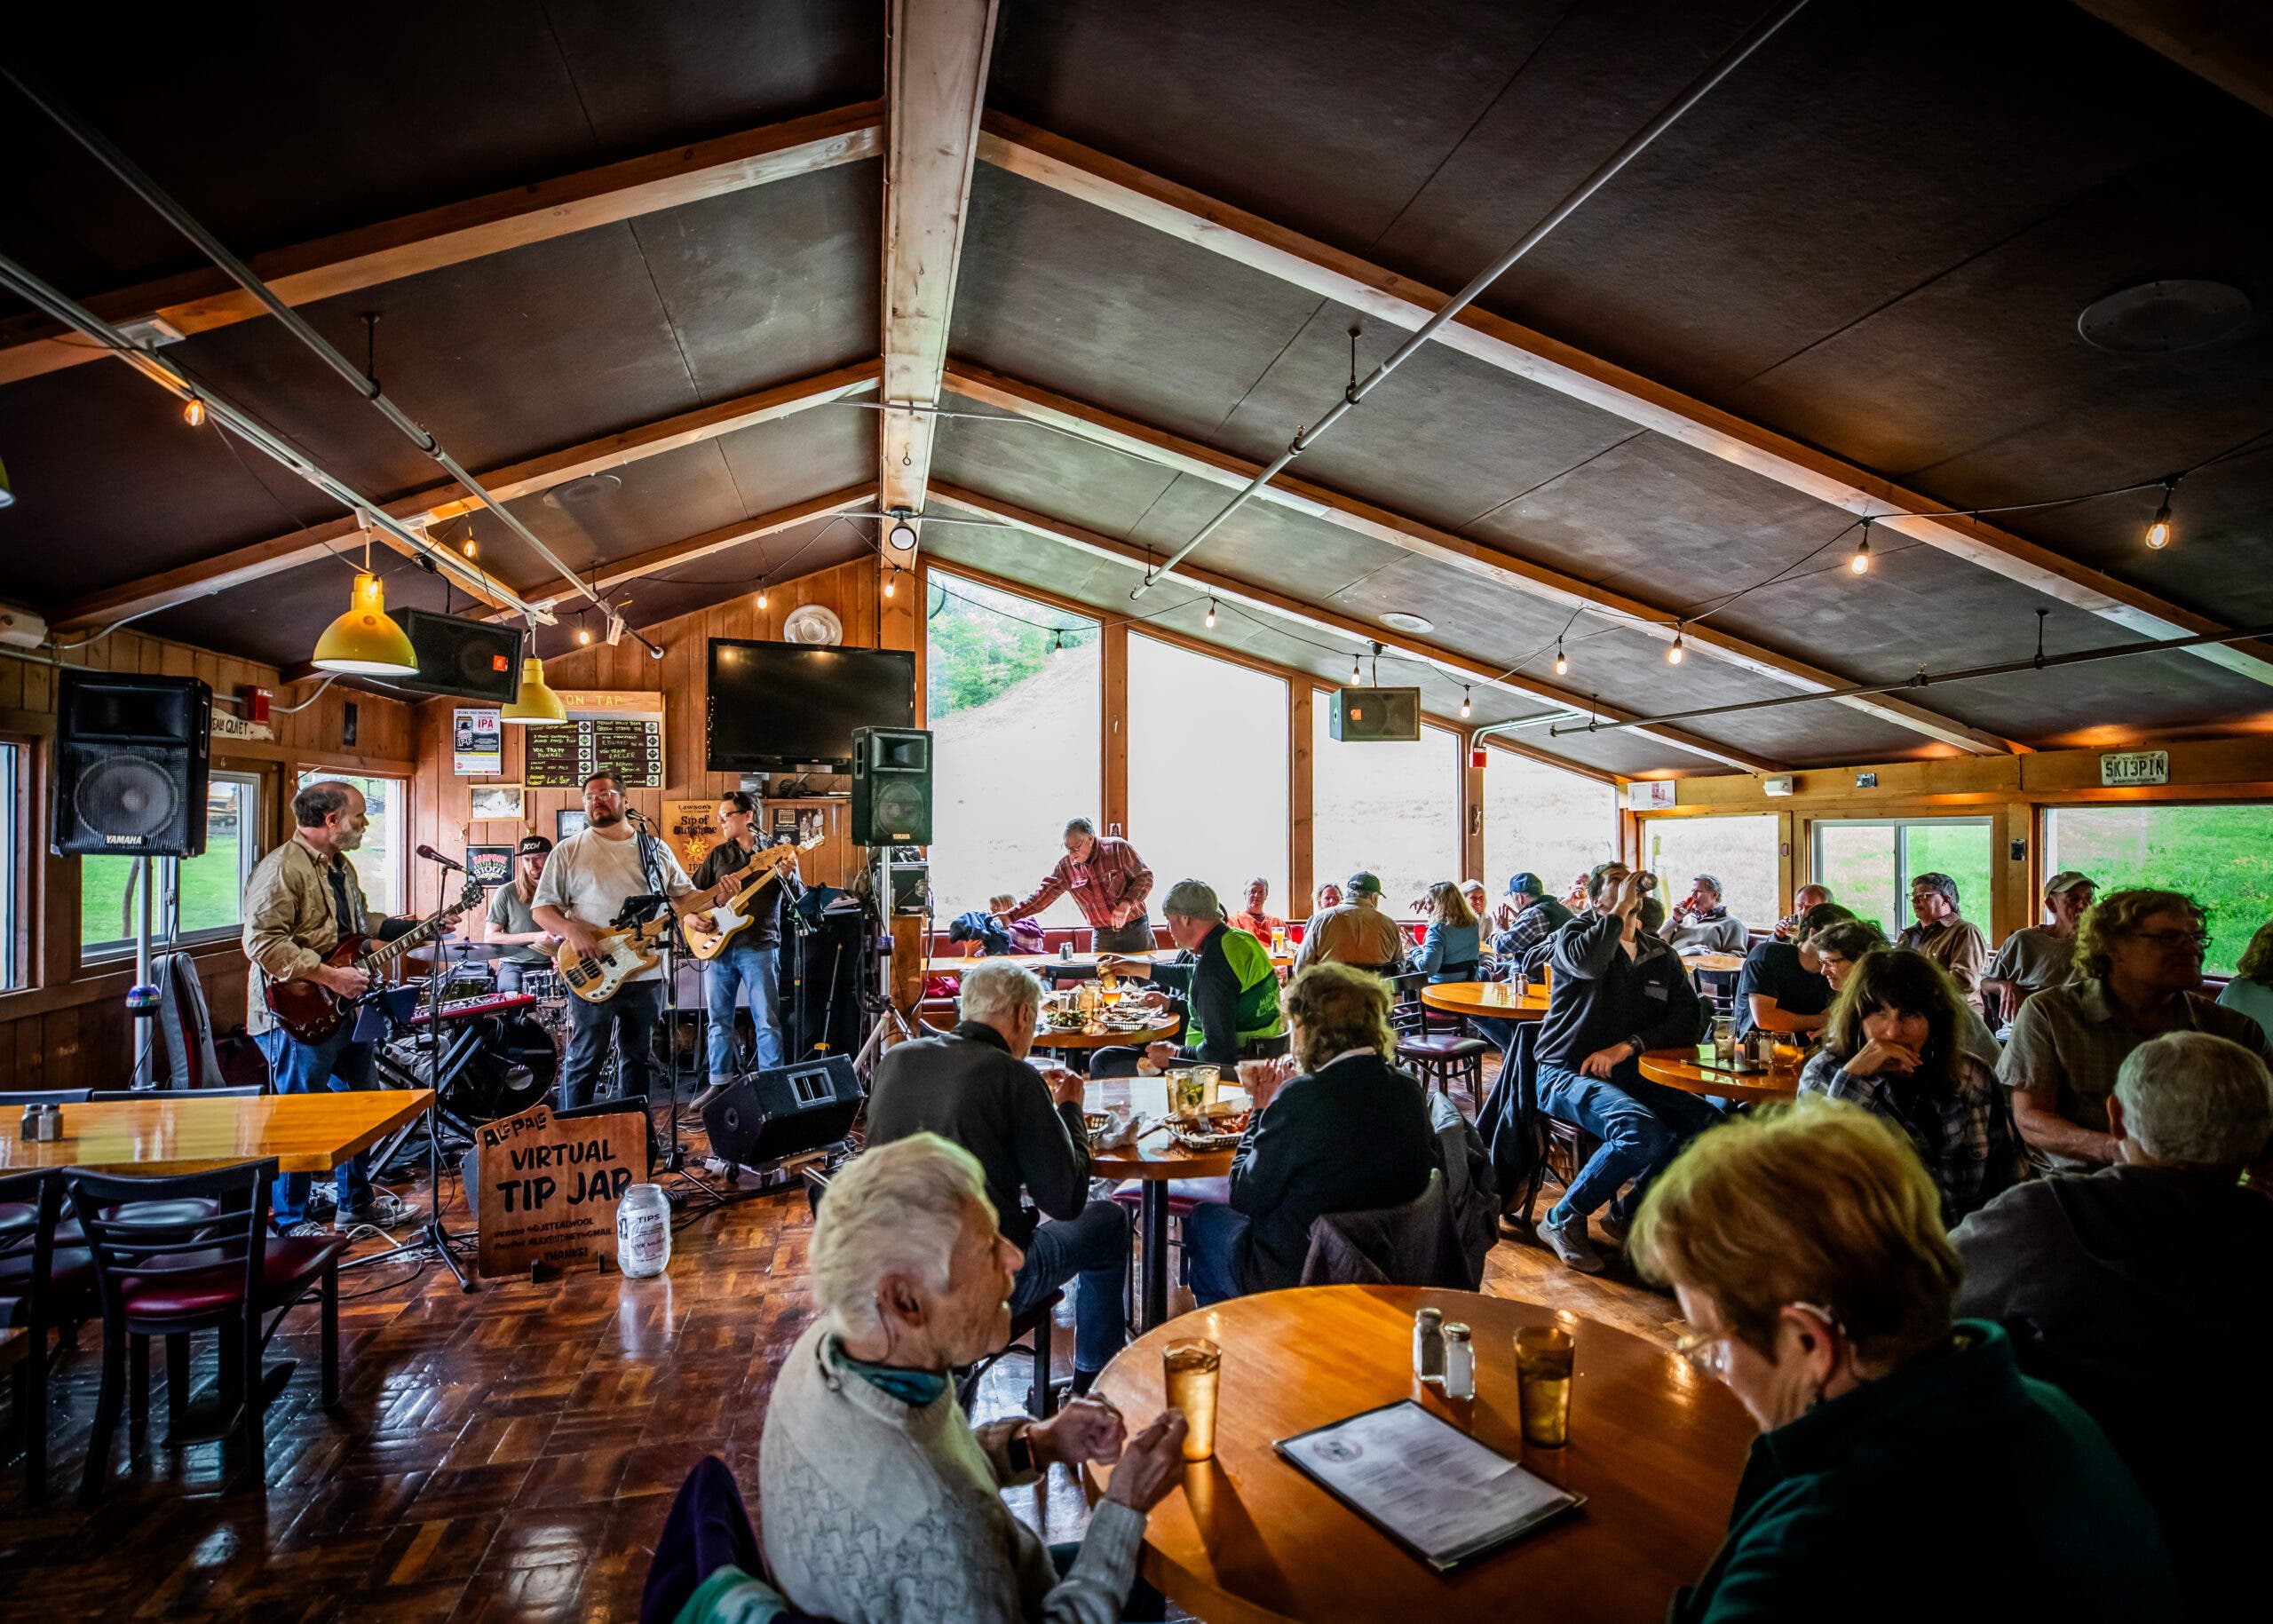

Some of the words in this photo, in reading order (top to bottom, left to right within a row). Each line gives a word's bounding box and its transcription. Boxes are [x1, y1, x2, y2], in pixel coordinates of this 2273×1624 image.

[566, 694, 584, 705] ON
[596, 695, 622, 707] TAP
[226, 719, 248, 735] QUIET
[478, 718, 494, 728] IPA
[681, 815, 697, 826] Sip
[698, 814, 710, 825] of
[673, 825, 717, 836] Sunshine
[107, 835, 142, 844] YAMAHA
[472, 853, 509, 866] HARPOON
[473, 866, 508, 877] STOUT
[511, 1112, 547, 1137] PALS
[511, 1139, 616, 1170] VIRTUAL
[496, 1176, 557, 1213] TIP
[566, 1167, 633, 1205] JAR
[637, 1213, 661, 1223] TIPS
[543, 1247, 588, 1261] THANKS!
